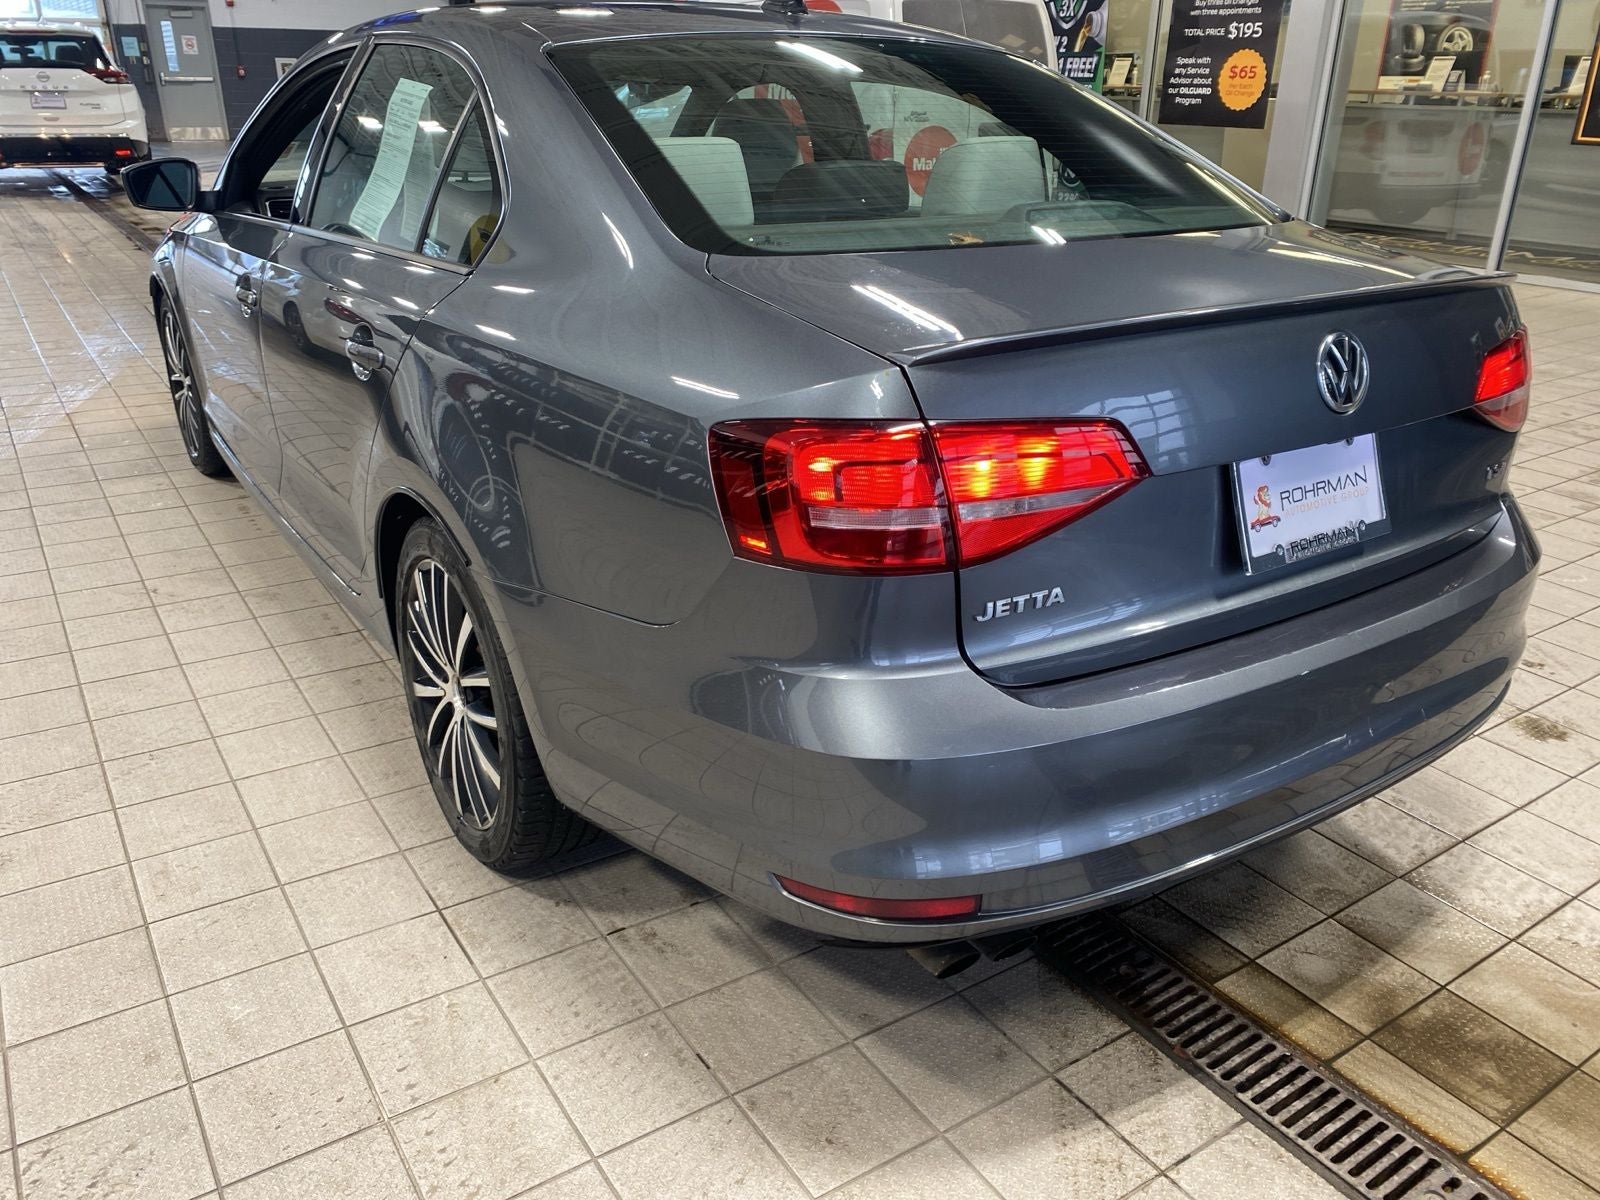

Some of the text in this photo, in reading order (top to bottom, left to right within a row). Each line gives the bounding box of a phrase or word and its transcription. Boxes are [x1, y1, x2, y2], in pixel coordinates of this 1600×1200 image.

[1218, 7, 1262, 16] appointments
[1184, 21, 1263, 39] TOTAL PRICE $195
[1065, 54, 1098, 77] FREE!
[1176, 56, 1211, 65] Speak with
[1174, 66, 1210, 75] any Service
[1229, 64, 1258, 80] $65
[1169, 76, 1212, 85] Advisor about
[1179, 87, 1211, 95] OILGUARD
[1175, 97, 1202, 106] Program
[1279, 465, 1368, 511] ROHRMAN
[1283, 486, 1369, 518] AUTOMOTIVE GROUP
[1289, 526, 1356, 556] ROHRMAN
[975, 586, 1065, 622] JETTA
